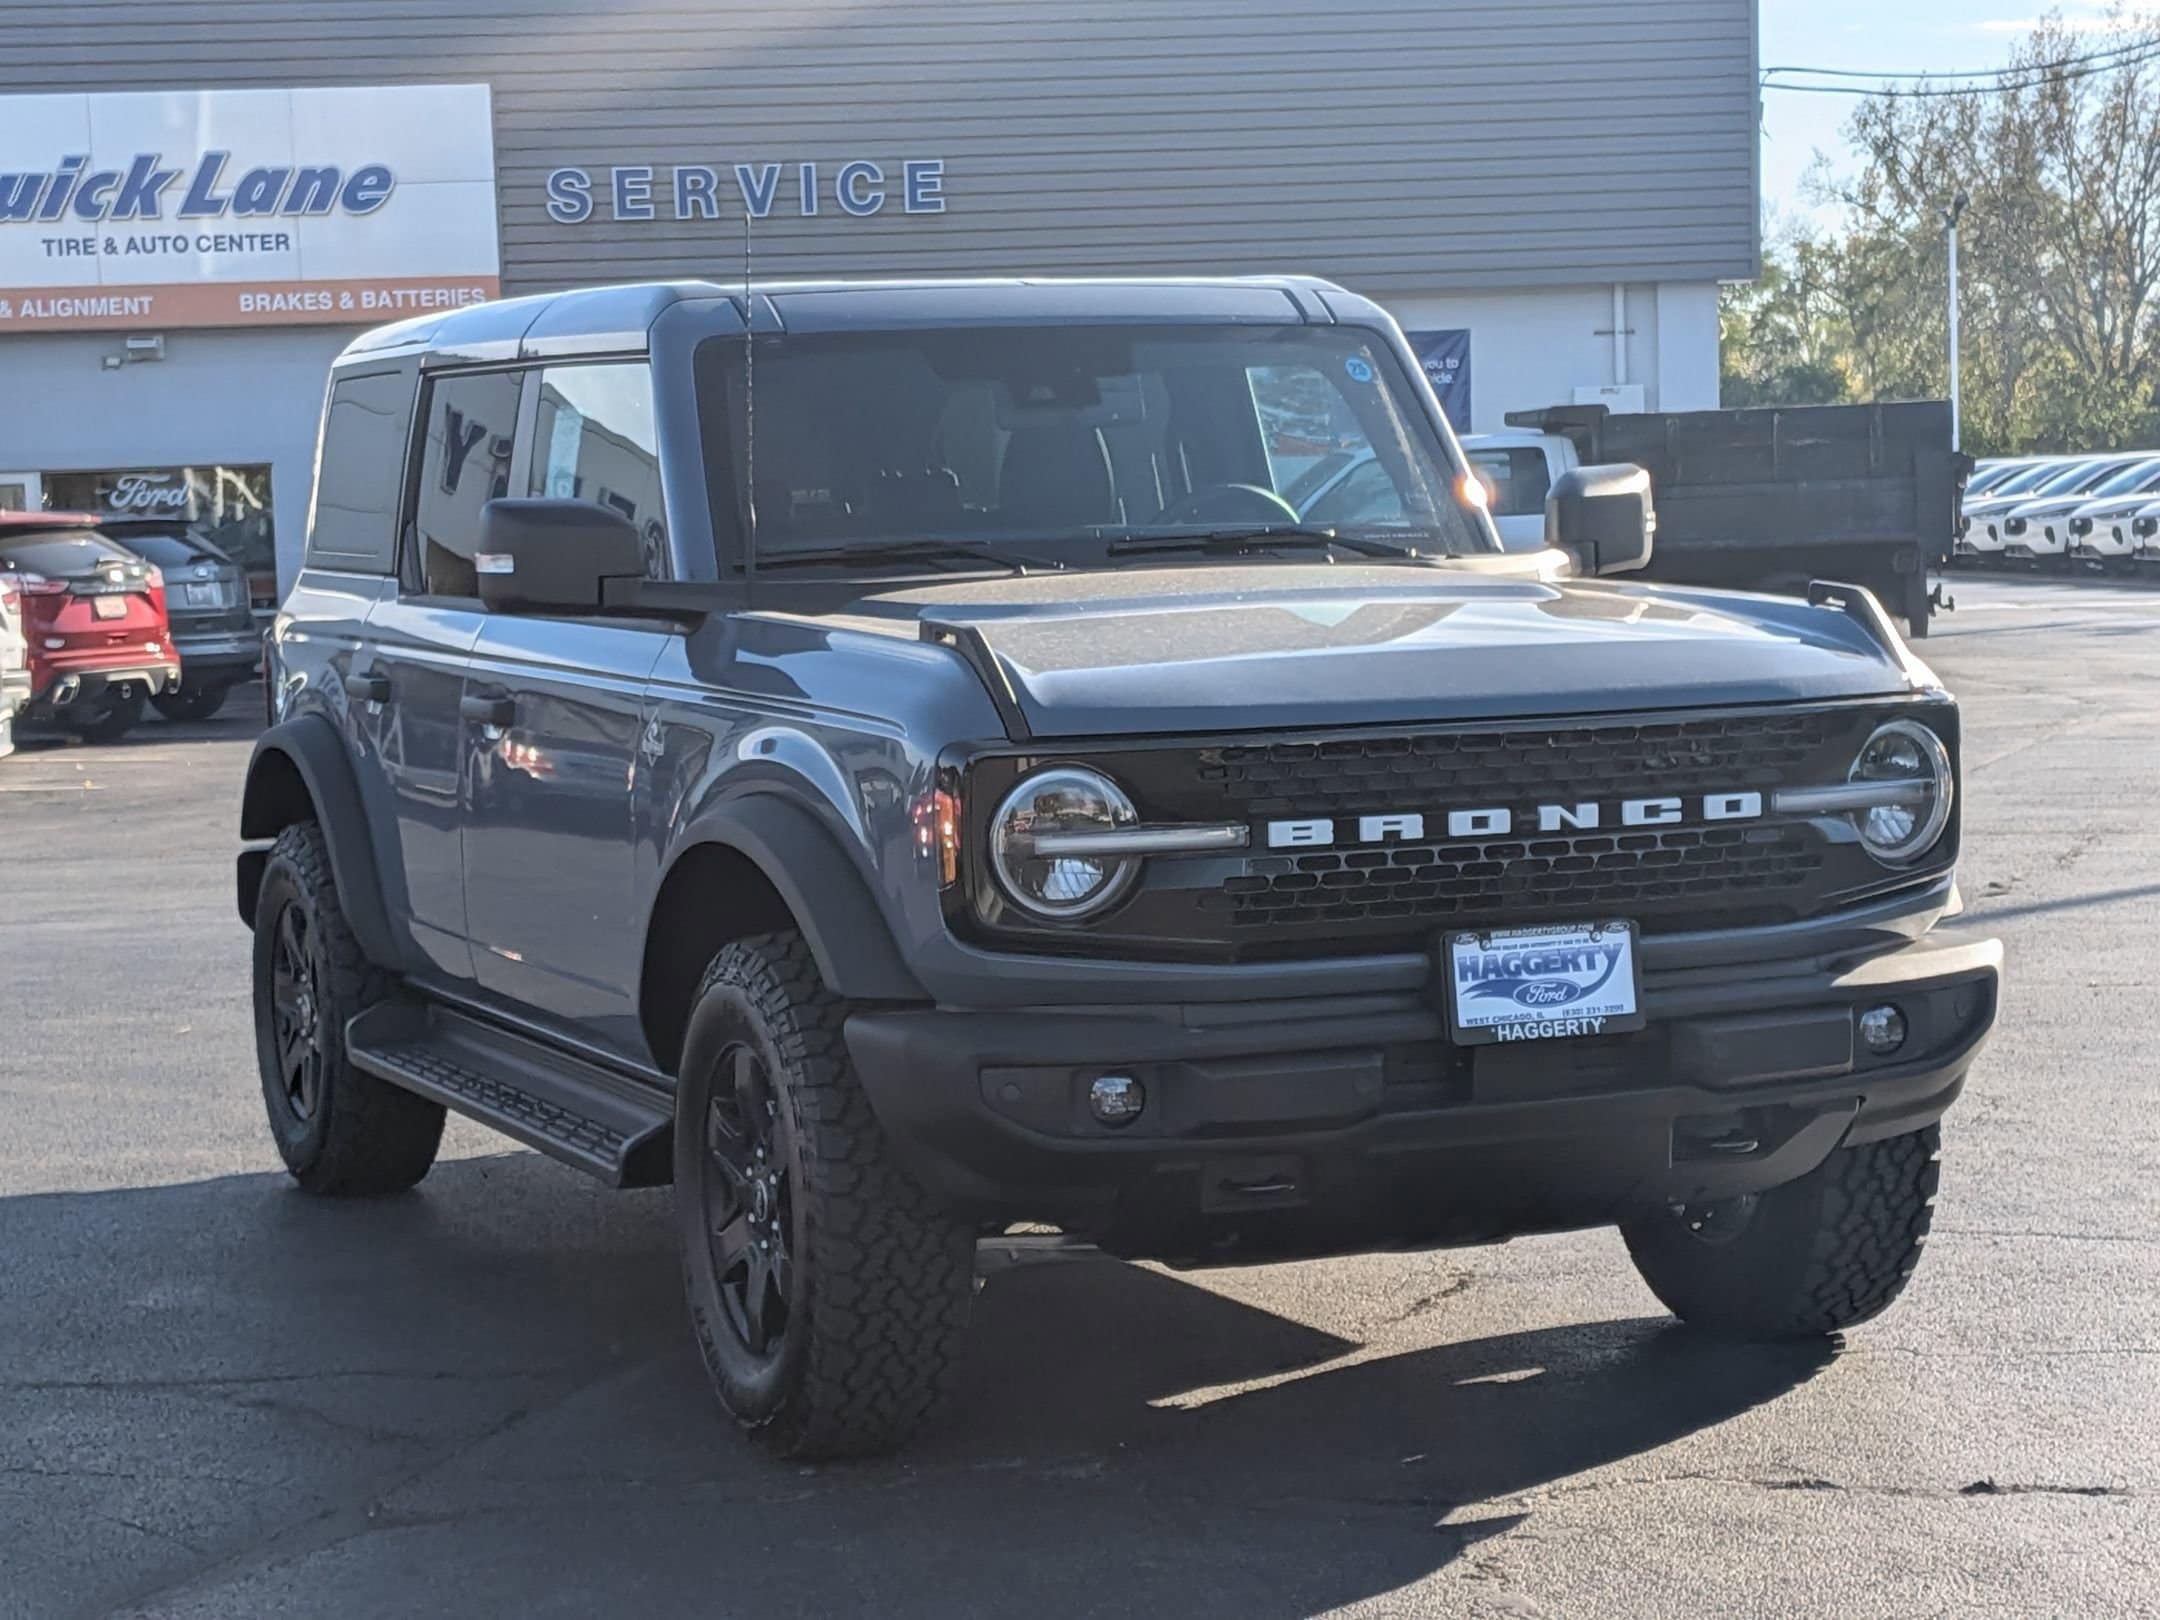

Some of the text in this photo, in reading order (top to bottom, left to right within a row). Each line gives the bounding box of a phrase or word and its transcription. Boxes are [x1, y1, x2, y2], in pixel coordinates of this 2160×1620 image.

[176, 149, 397, 220] Lane
[545, 160, 947, 224] SERVICE
[42, 232, 290, 257] TIRE & AUTO CENTER
[20, 295, 154, 318] ALIGNMENT
[239, 287, 486, 312] BRAKES & BATTERIES
[1446, 357, 1460, 370] to
[109, 475, 190, 508] Ford
[1267, 791, 1763, 848] BRONCO
[1457, 943, 1625, 983] HAGGERTY
[1526, 983, 1568, 1004] Ford
[1497, 1017, 1602, 1042] HAGGERTY
